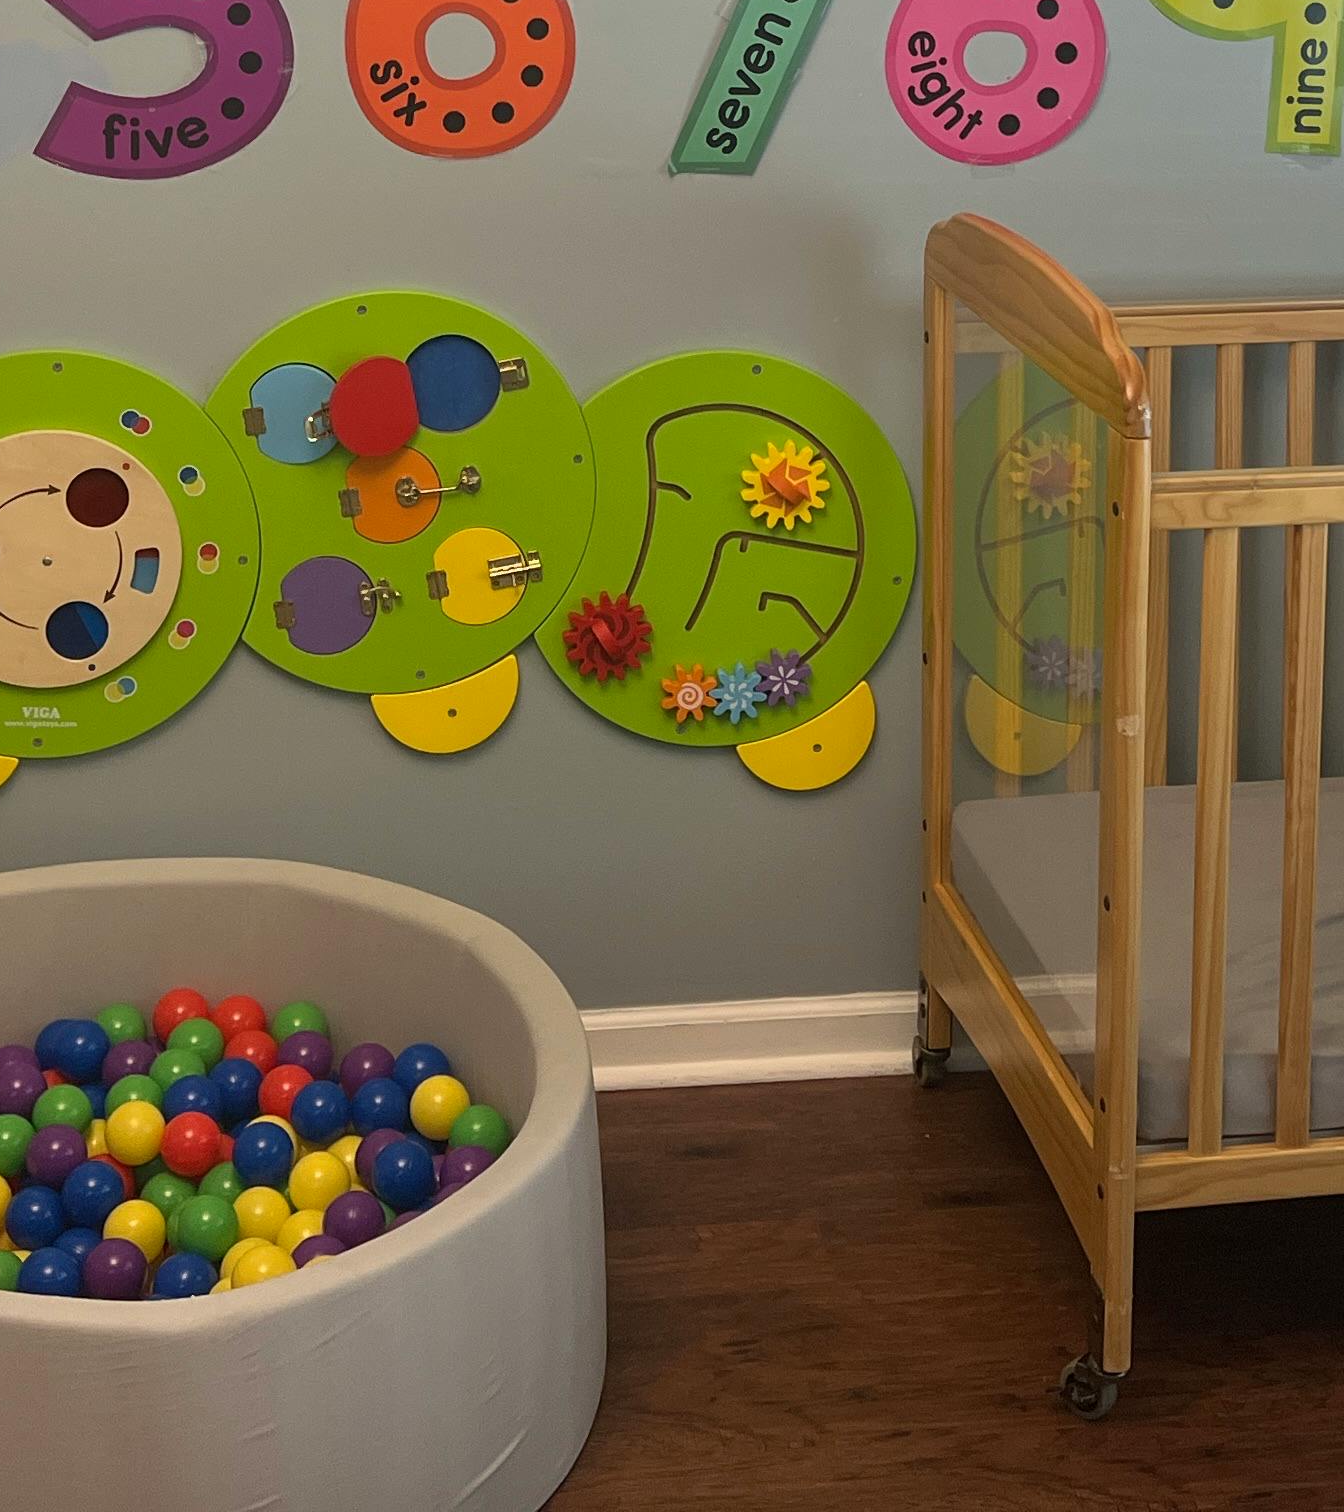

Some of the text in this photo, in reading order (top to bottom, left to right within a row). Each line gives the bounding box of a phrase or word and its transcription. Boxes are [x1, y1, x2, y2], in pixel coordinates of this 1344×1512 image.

[370, 58, 428, 127] six
[705, 11, 792, 155] seven
[908, 30, 983, 140] eight
[1287, 37, 1329, 135] nine
[103, 113, 210, 161] five
[21, 706, 61, 719] VIGA
